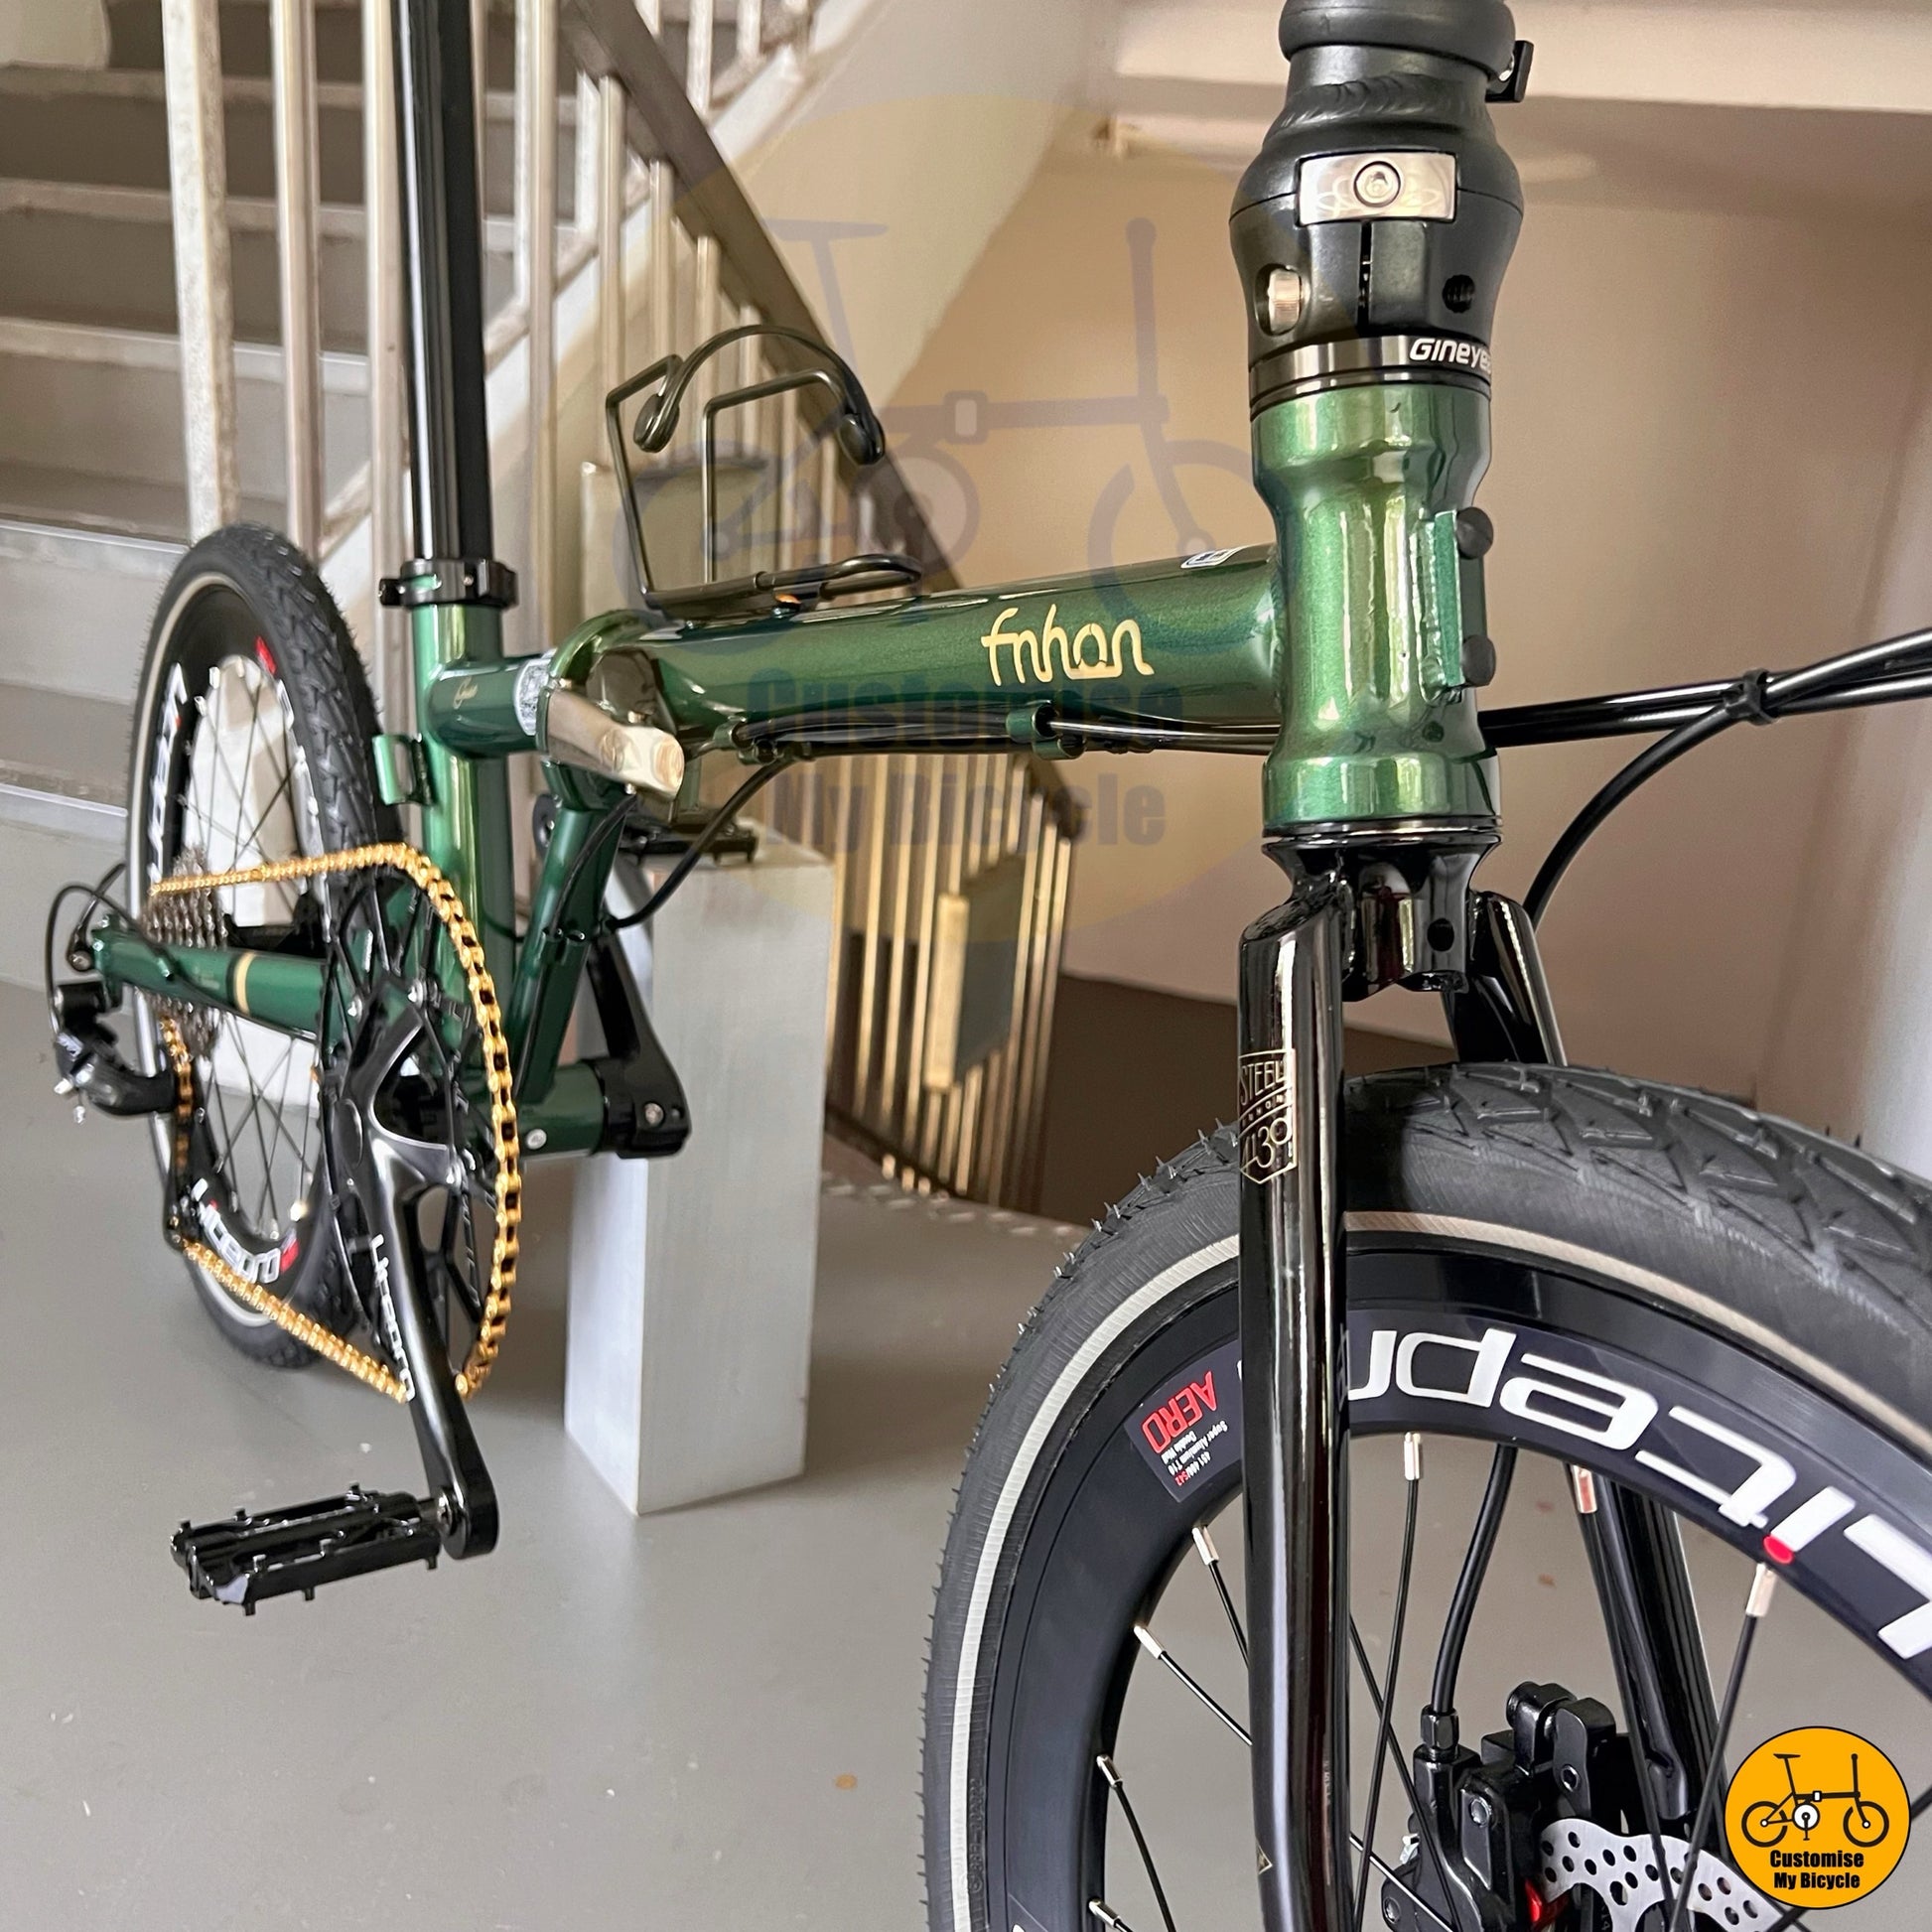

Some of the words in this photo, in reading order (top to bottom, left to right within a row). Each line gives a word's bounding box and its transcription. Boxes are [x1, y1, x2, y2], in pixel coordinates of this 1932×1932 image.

[1241, 1060, 1287, 1106] STEEL
[1142, 1369, 1217, 1454] AERO
[1207, 1420, 1228, 1443] Super
